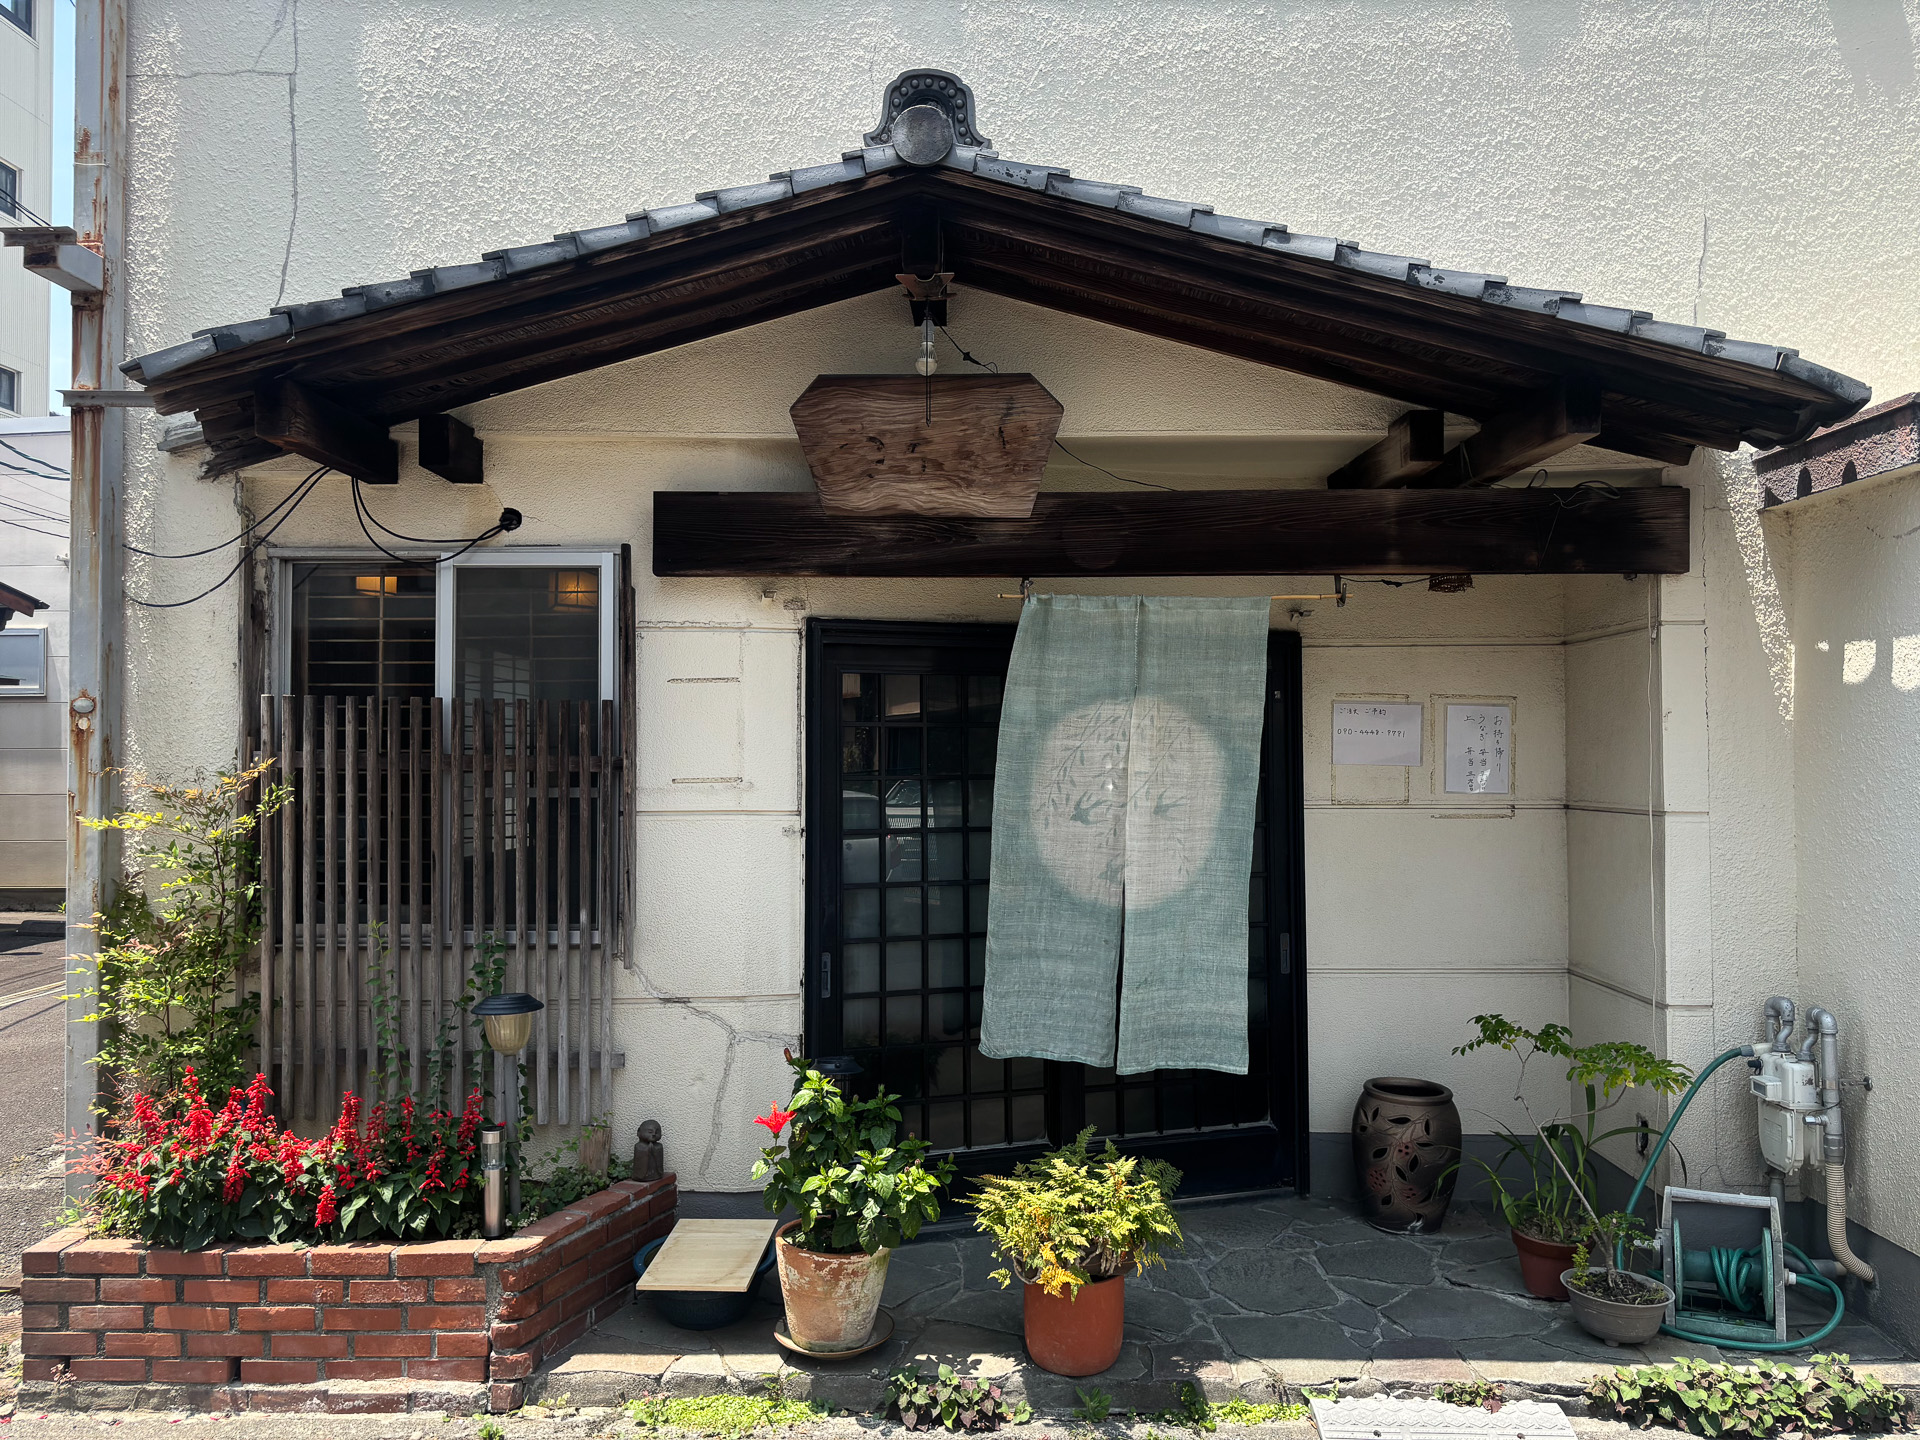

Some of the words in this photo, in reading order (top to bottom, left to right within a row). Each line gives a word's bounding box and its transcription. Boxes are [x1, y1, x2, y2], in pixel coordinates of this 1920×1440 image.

[1364, 707, 1387, 716] ご予約
[1493, 715, 1505, 772] お持ち帰り
